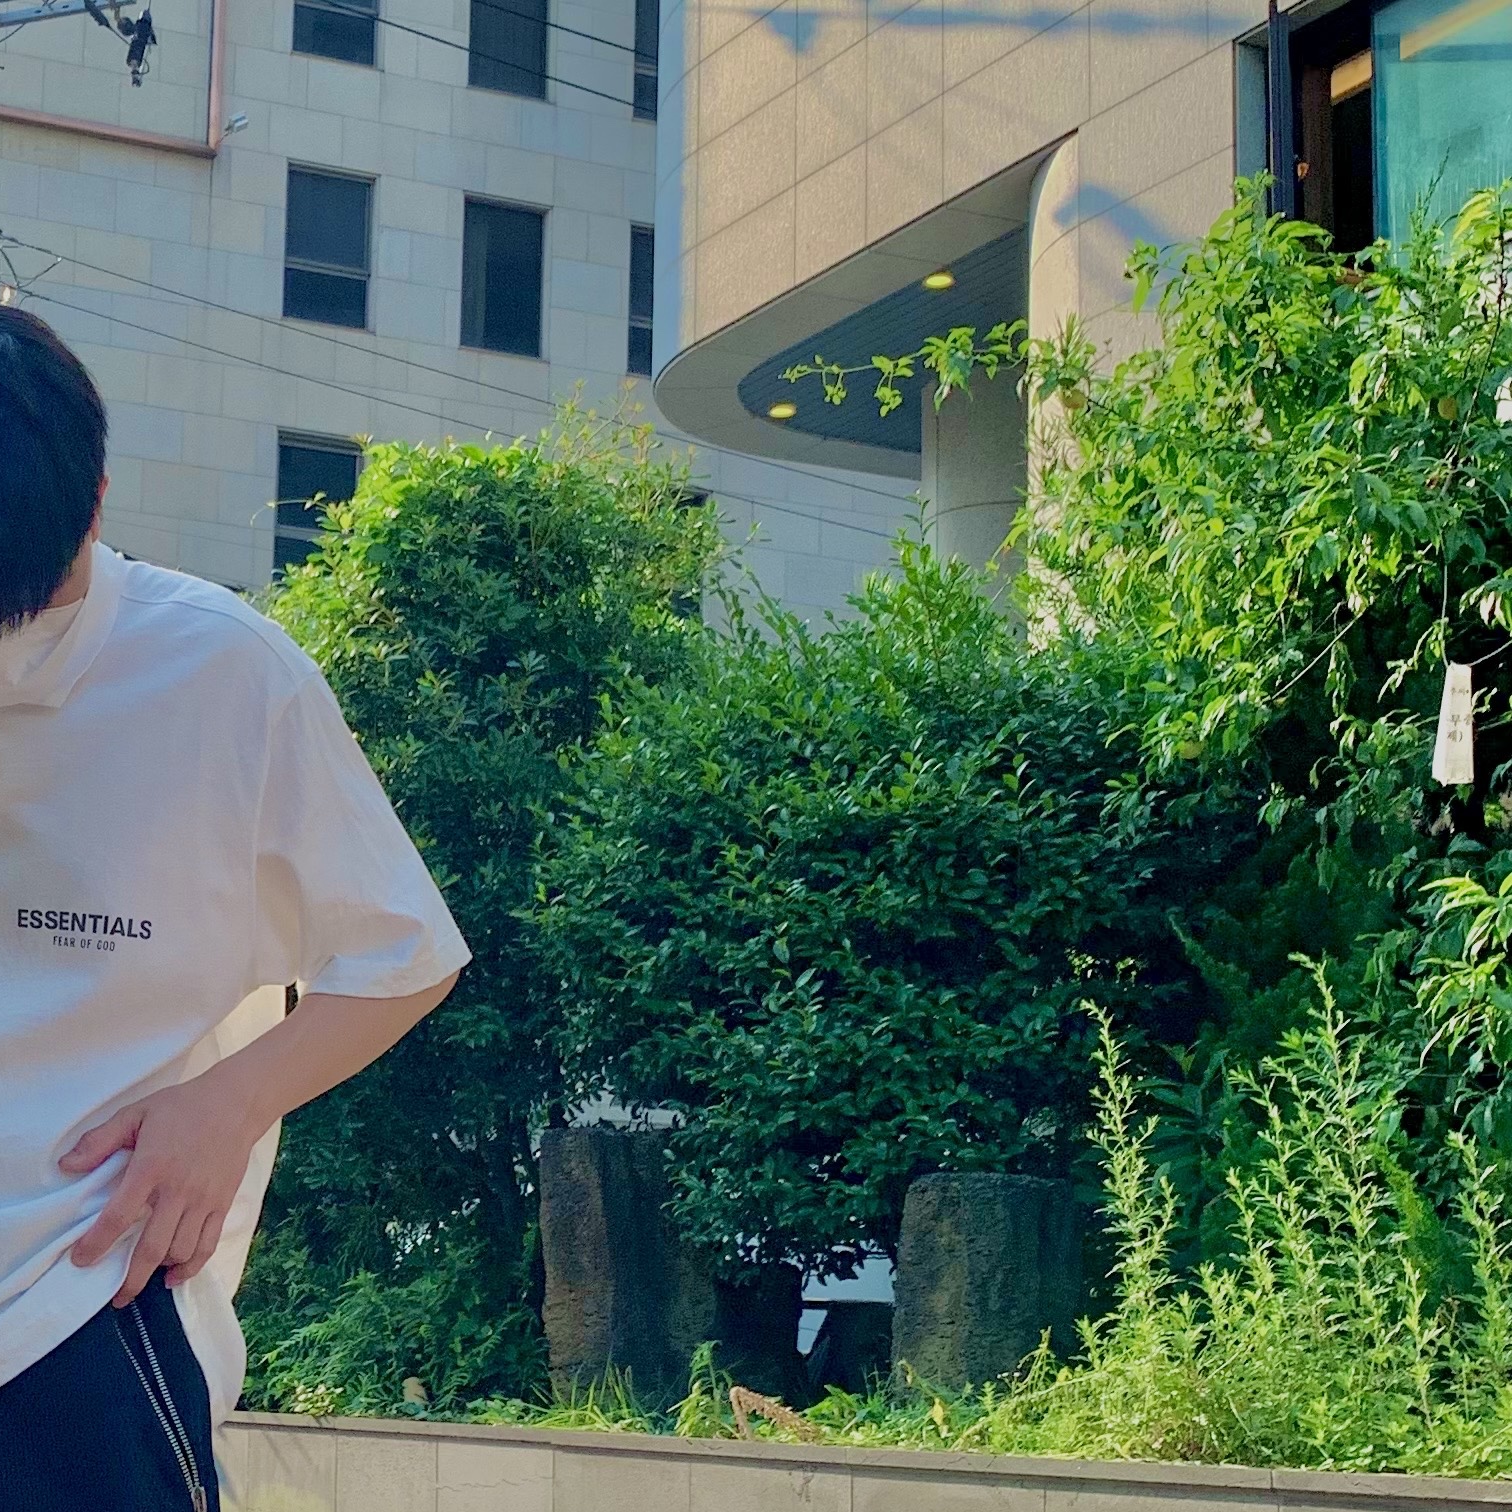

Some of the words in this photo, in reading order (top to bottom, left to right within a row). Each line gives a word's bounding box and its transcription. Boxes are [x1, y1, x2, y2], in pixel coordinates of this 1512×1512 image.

[17, 908, 152, 940] ESSENTIALS
[53, 935, 76, 948] FEAR
[80, 938, 92, 949] OF
[96, 940, 116, 951] GOD
